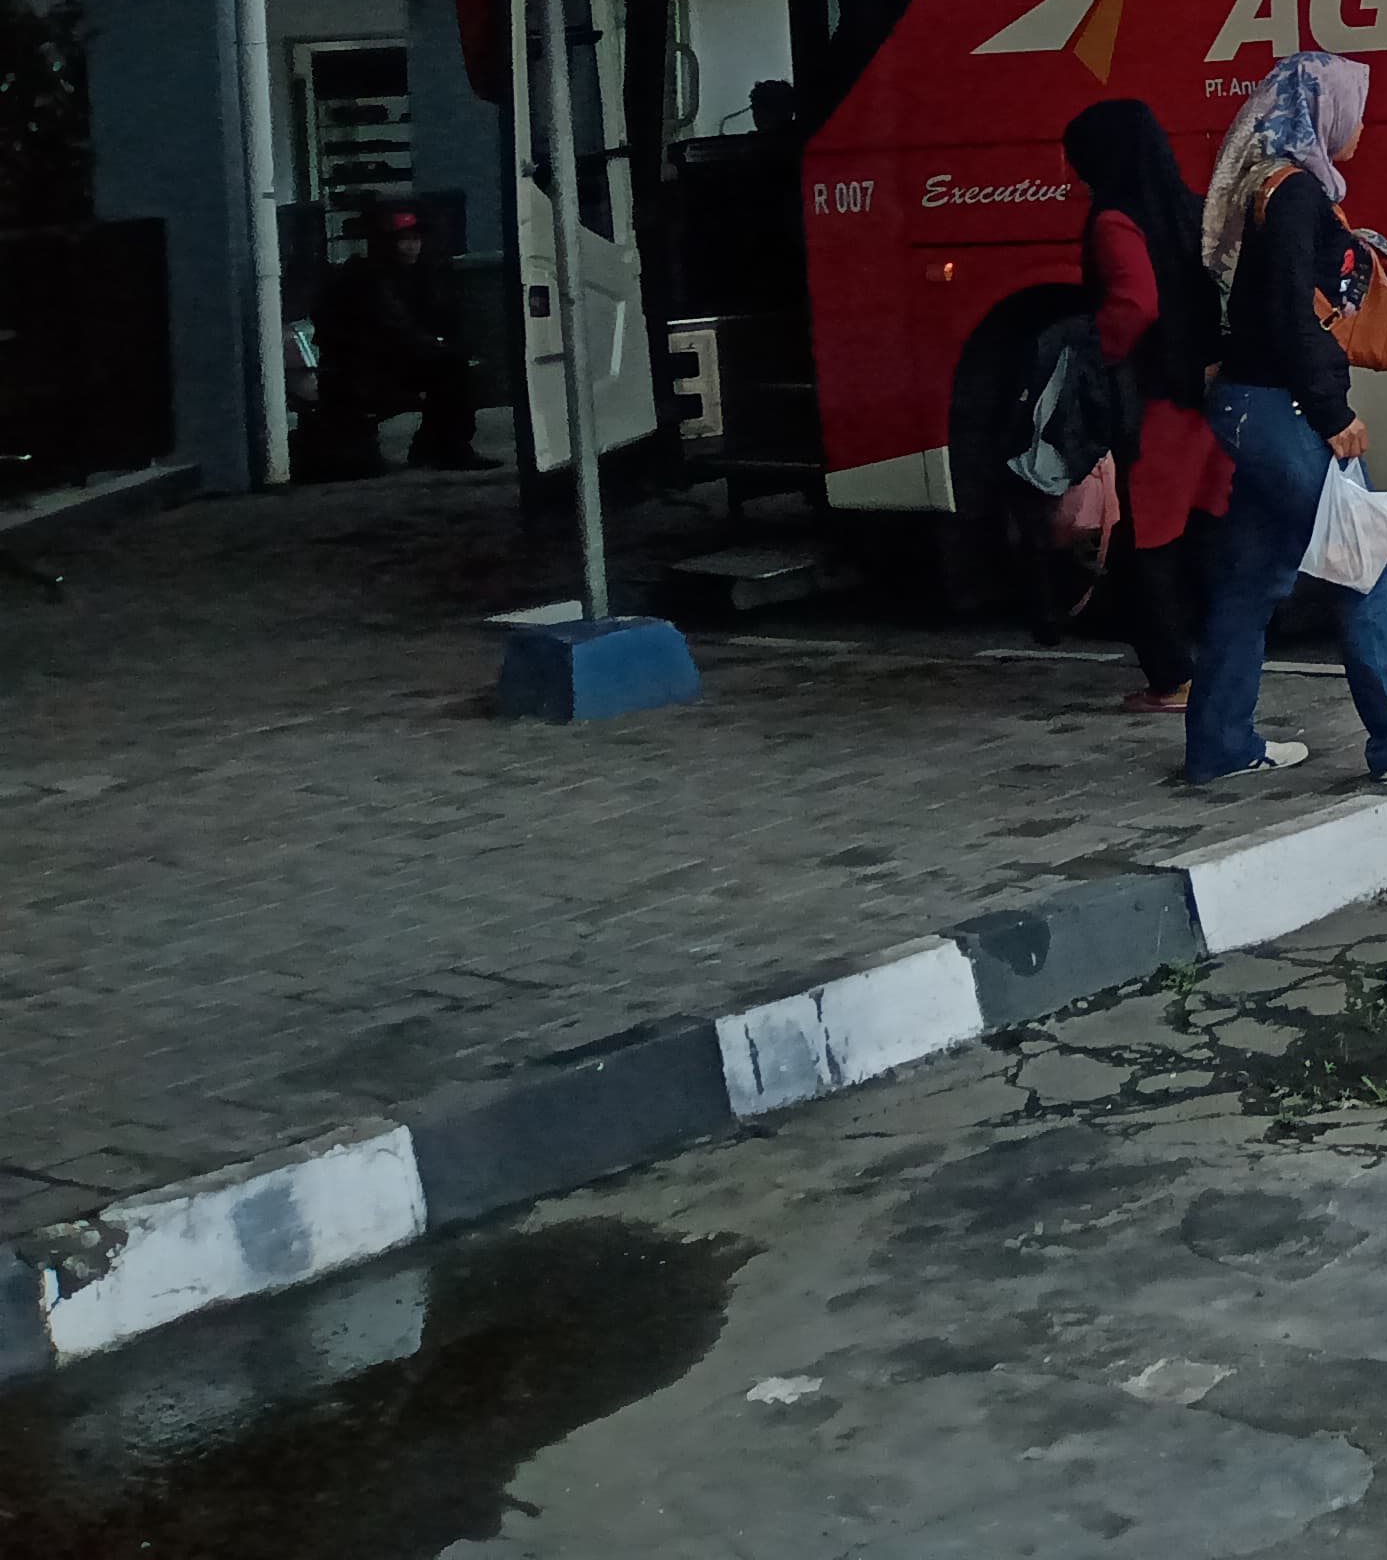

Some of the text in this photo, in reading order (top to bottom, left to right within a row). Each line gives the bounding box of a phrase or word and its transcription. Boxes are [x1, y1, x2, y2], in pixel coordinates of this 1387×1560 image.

[1204, 77, 1227, 98] PT.
[813, 180, 875, 215] R 007
[921, 174, 1073, 208] Executive
